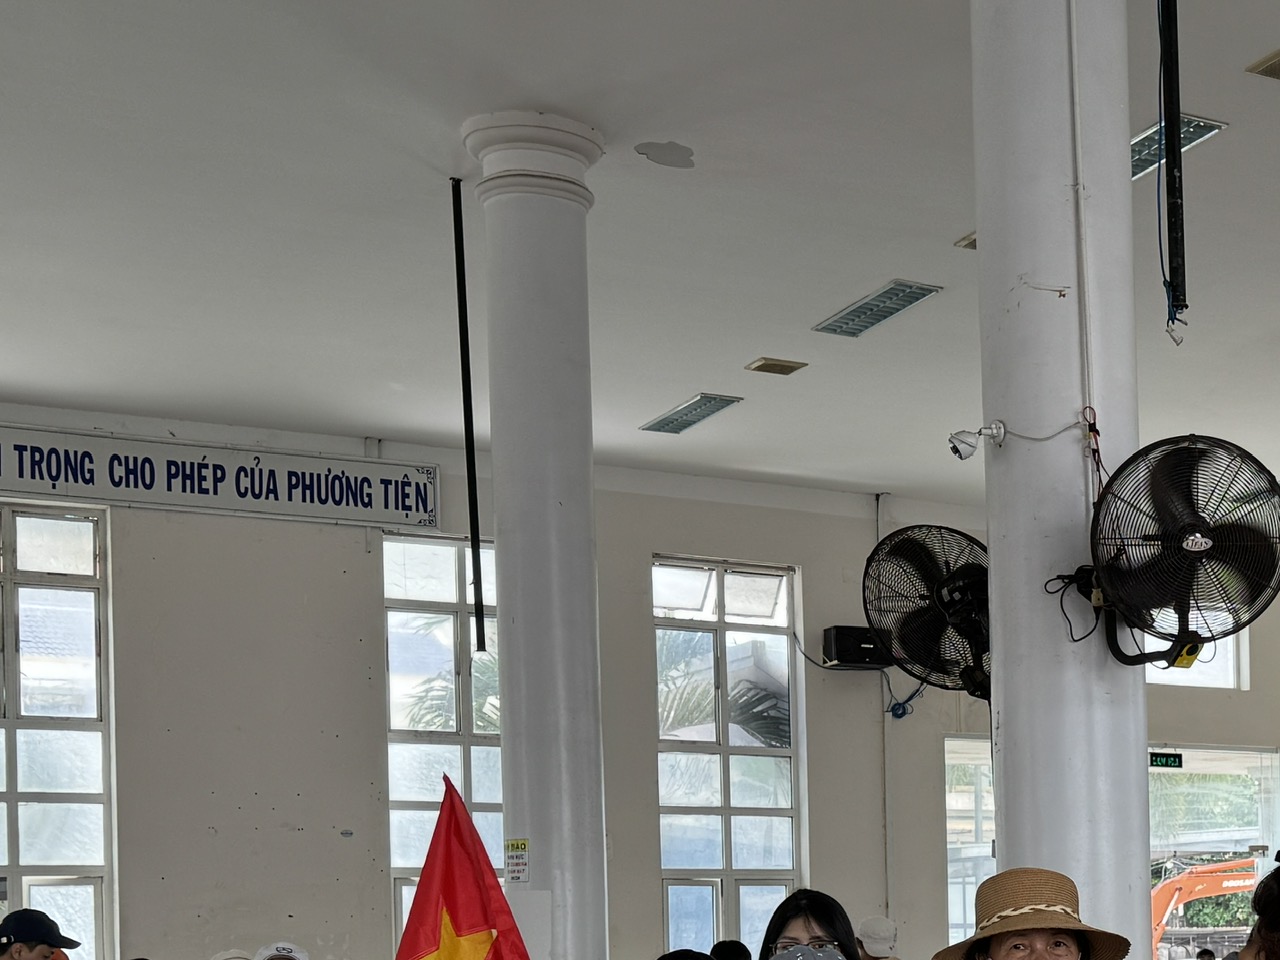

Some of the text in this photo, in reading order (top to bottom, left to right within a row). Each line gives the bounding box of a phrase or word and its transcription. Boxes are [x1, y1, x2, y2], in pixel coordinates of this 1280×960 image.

[13, 444, 95, 489] TRỌNG
[108, 453, 156, 489] CHO
[166, 456, 226, 496] PHÉP
[234, 457, 280, 501] CỦA
[287, 468, 373, 509] PHƯƠNG
[380, 474, 429, 518] TIỆN
